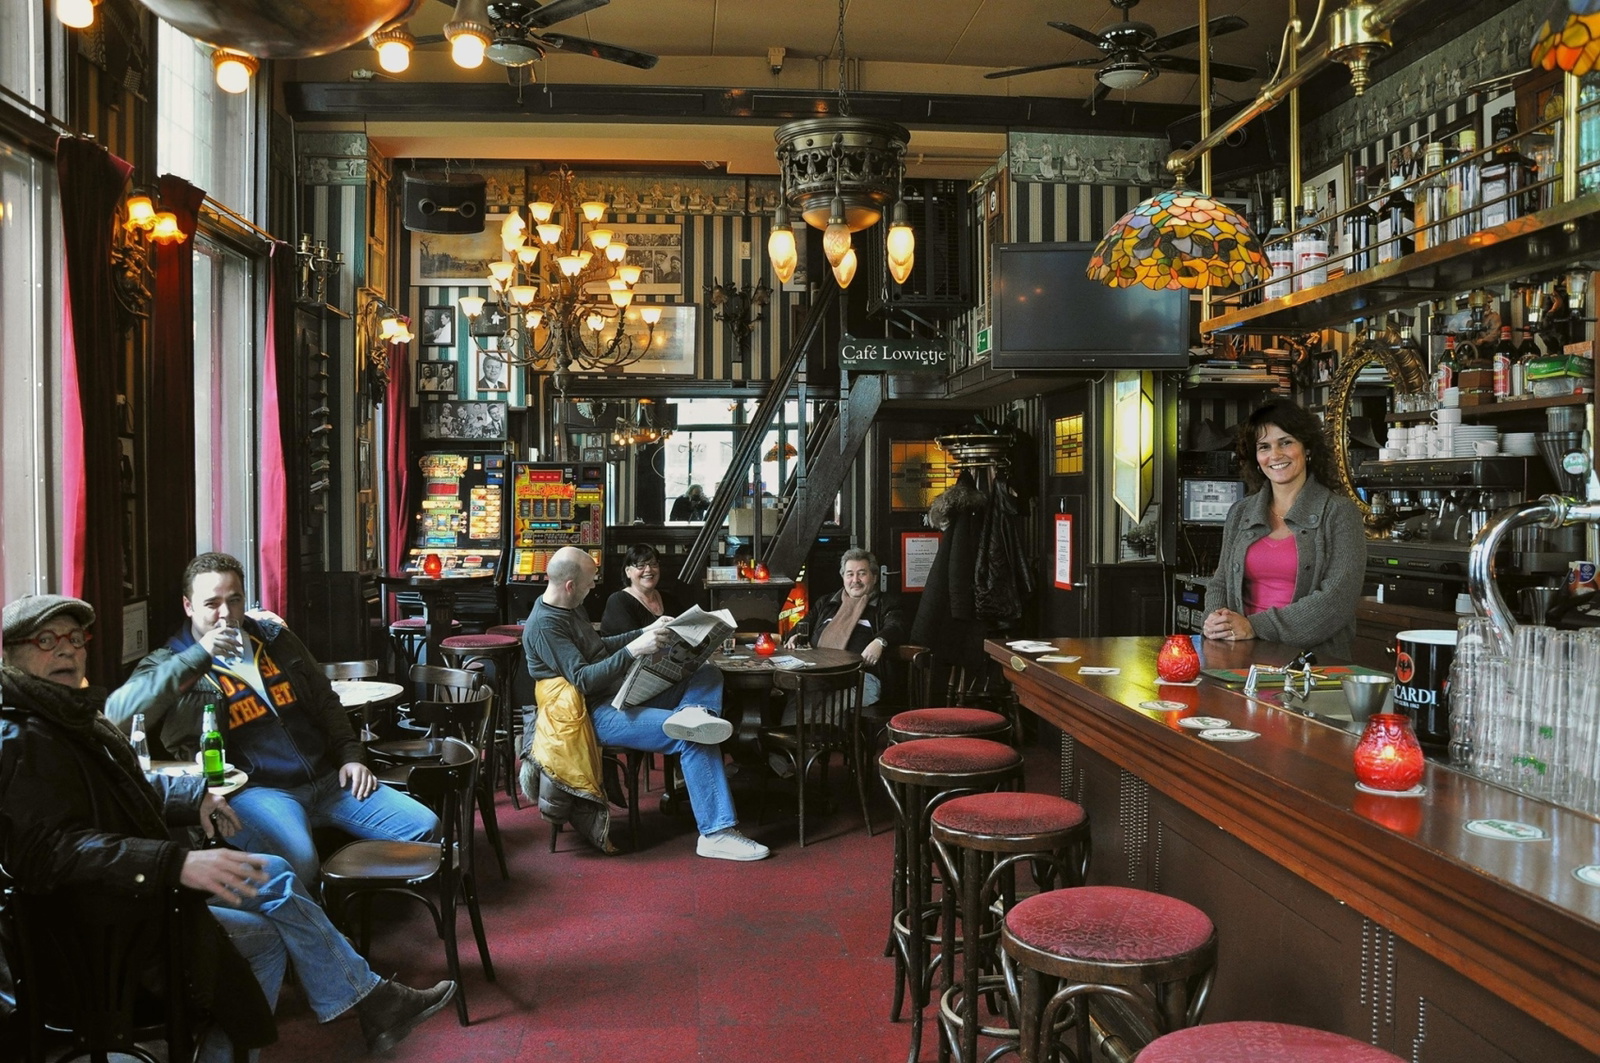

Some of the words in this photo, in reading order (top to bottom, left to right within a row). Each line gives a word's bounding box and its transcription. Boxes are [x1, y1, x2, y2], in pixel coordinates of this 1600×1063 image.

[841, 345, 878, 360] Café
[882, 345, 947, 365] Lowietje
[1394, 684, 1436, 705] CARDI
